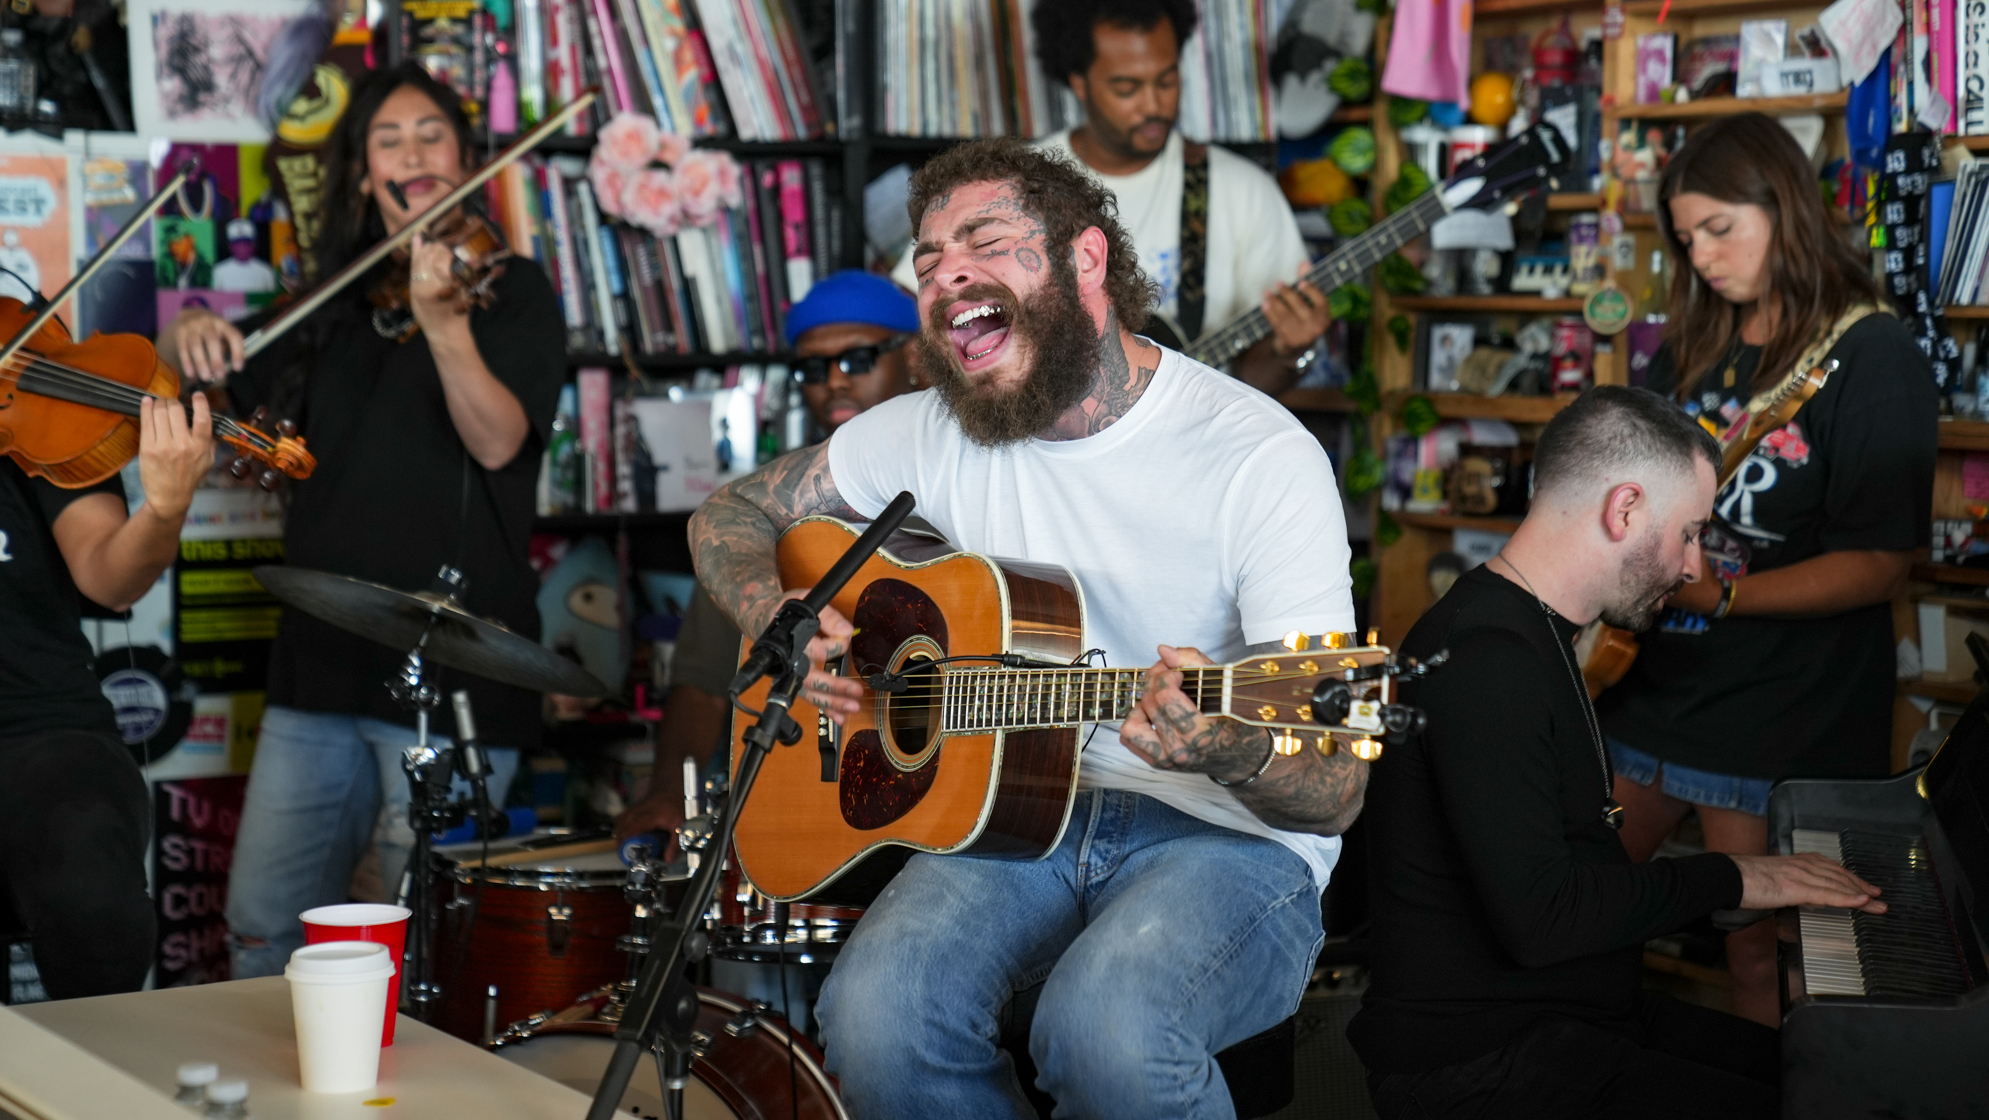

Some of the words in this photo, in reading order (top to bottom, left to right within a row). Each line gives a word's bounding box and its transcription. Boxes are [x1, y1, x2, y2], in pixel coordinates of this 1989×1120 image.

[1966, 75, 1986, 134] CALL
[180, 539, 228, 561] this
[160, 834, 233, 873] STR
[162, 883, 229, 921] COU
